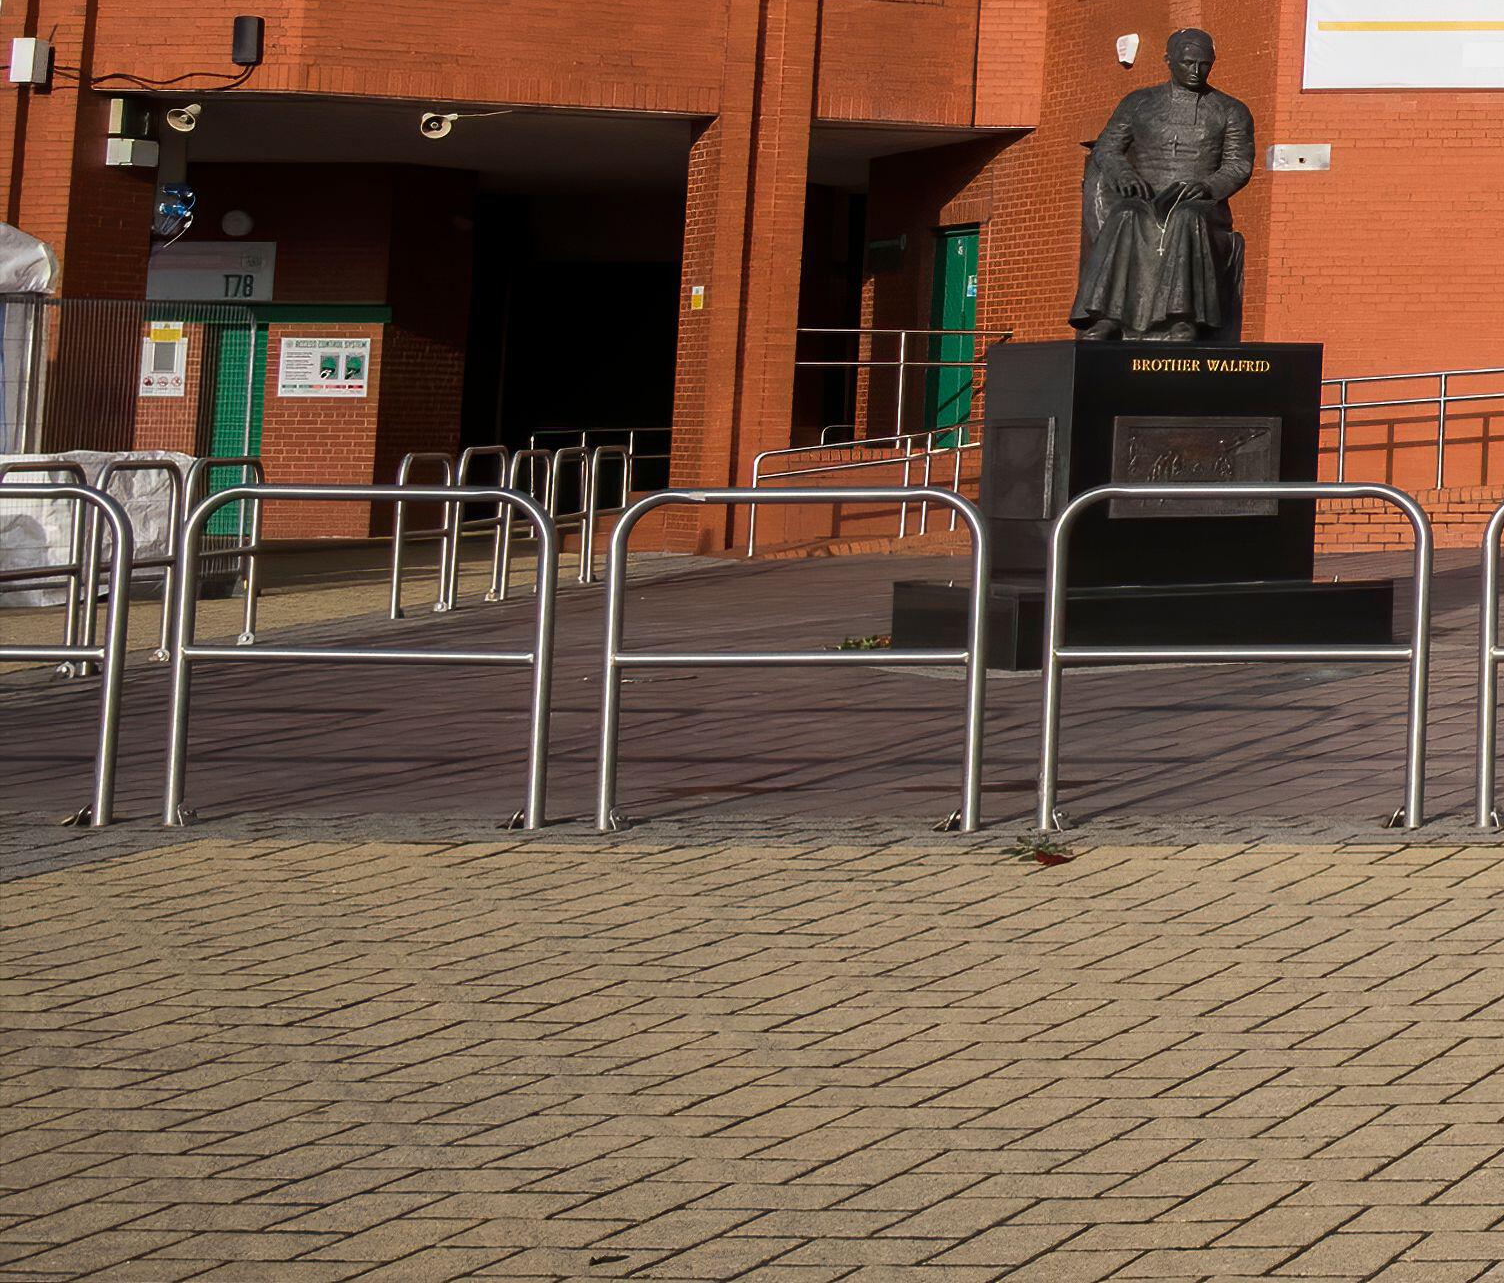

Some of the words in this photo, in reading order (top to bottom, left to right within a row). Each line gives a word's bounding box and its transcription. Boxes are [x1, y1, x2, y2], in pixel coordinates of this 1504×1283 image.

[223, 274, 254, 297] T78
[1132, 359, 1200, 372] BROTHER
[1206, 359, 1270, 372] WALFRID
